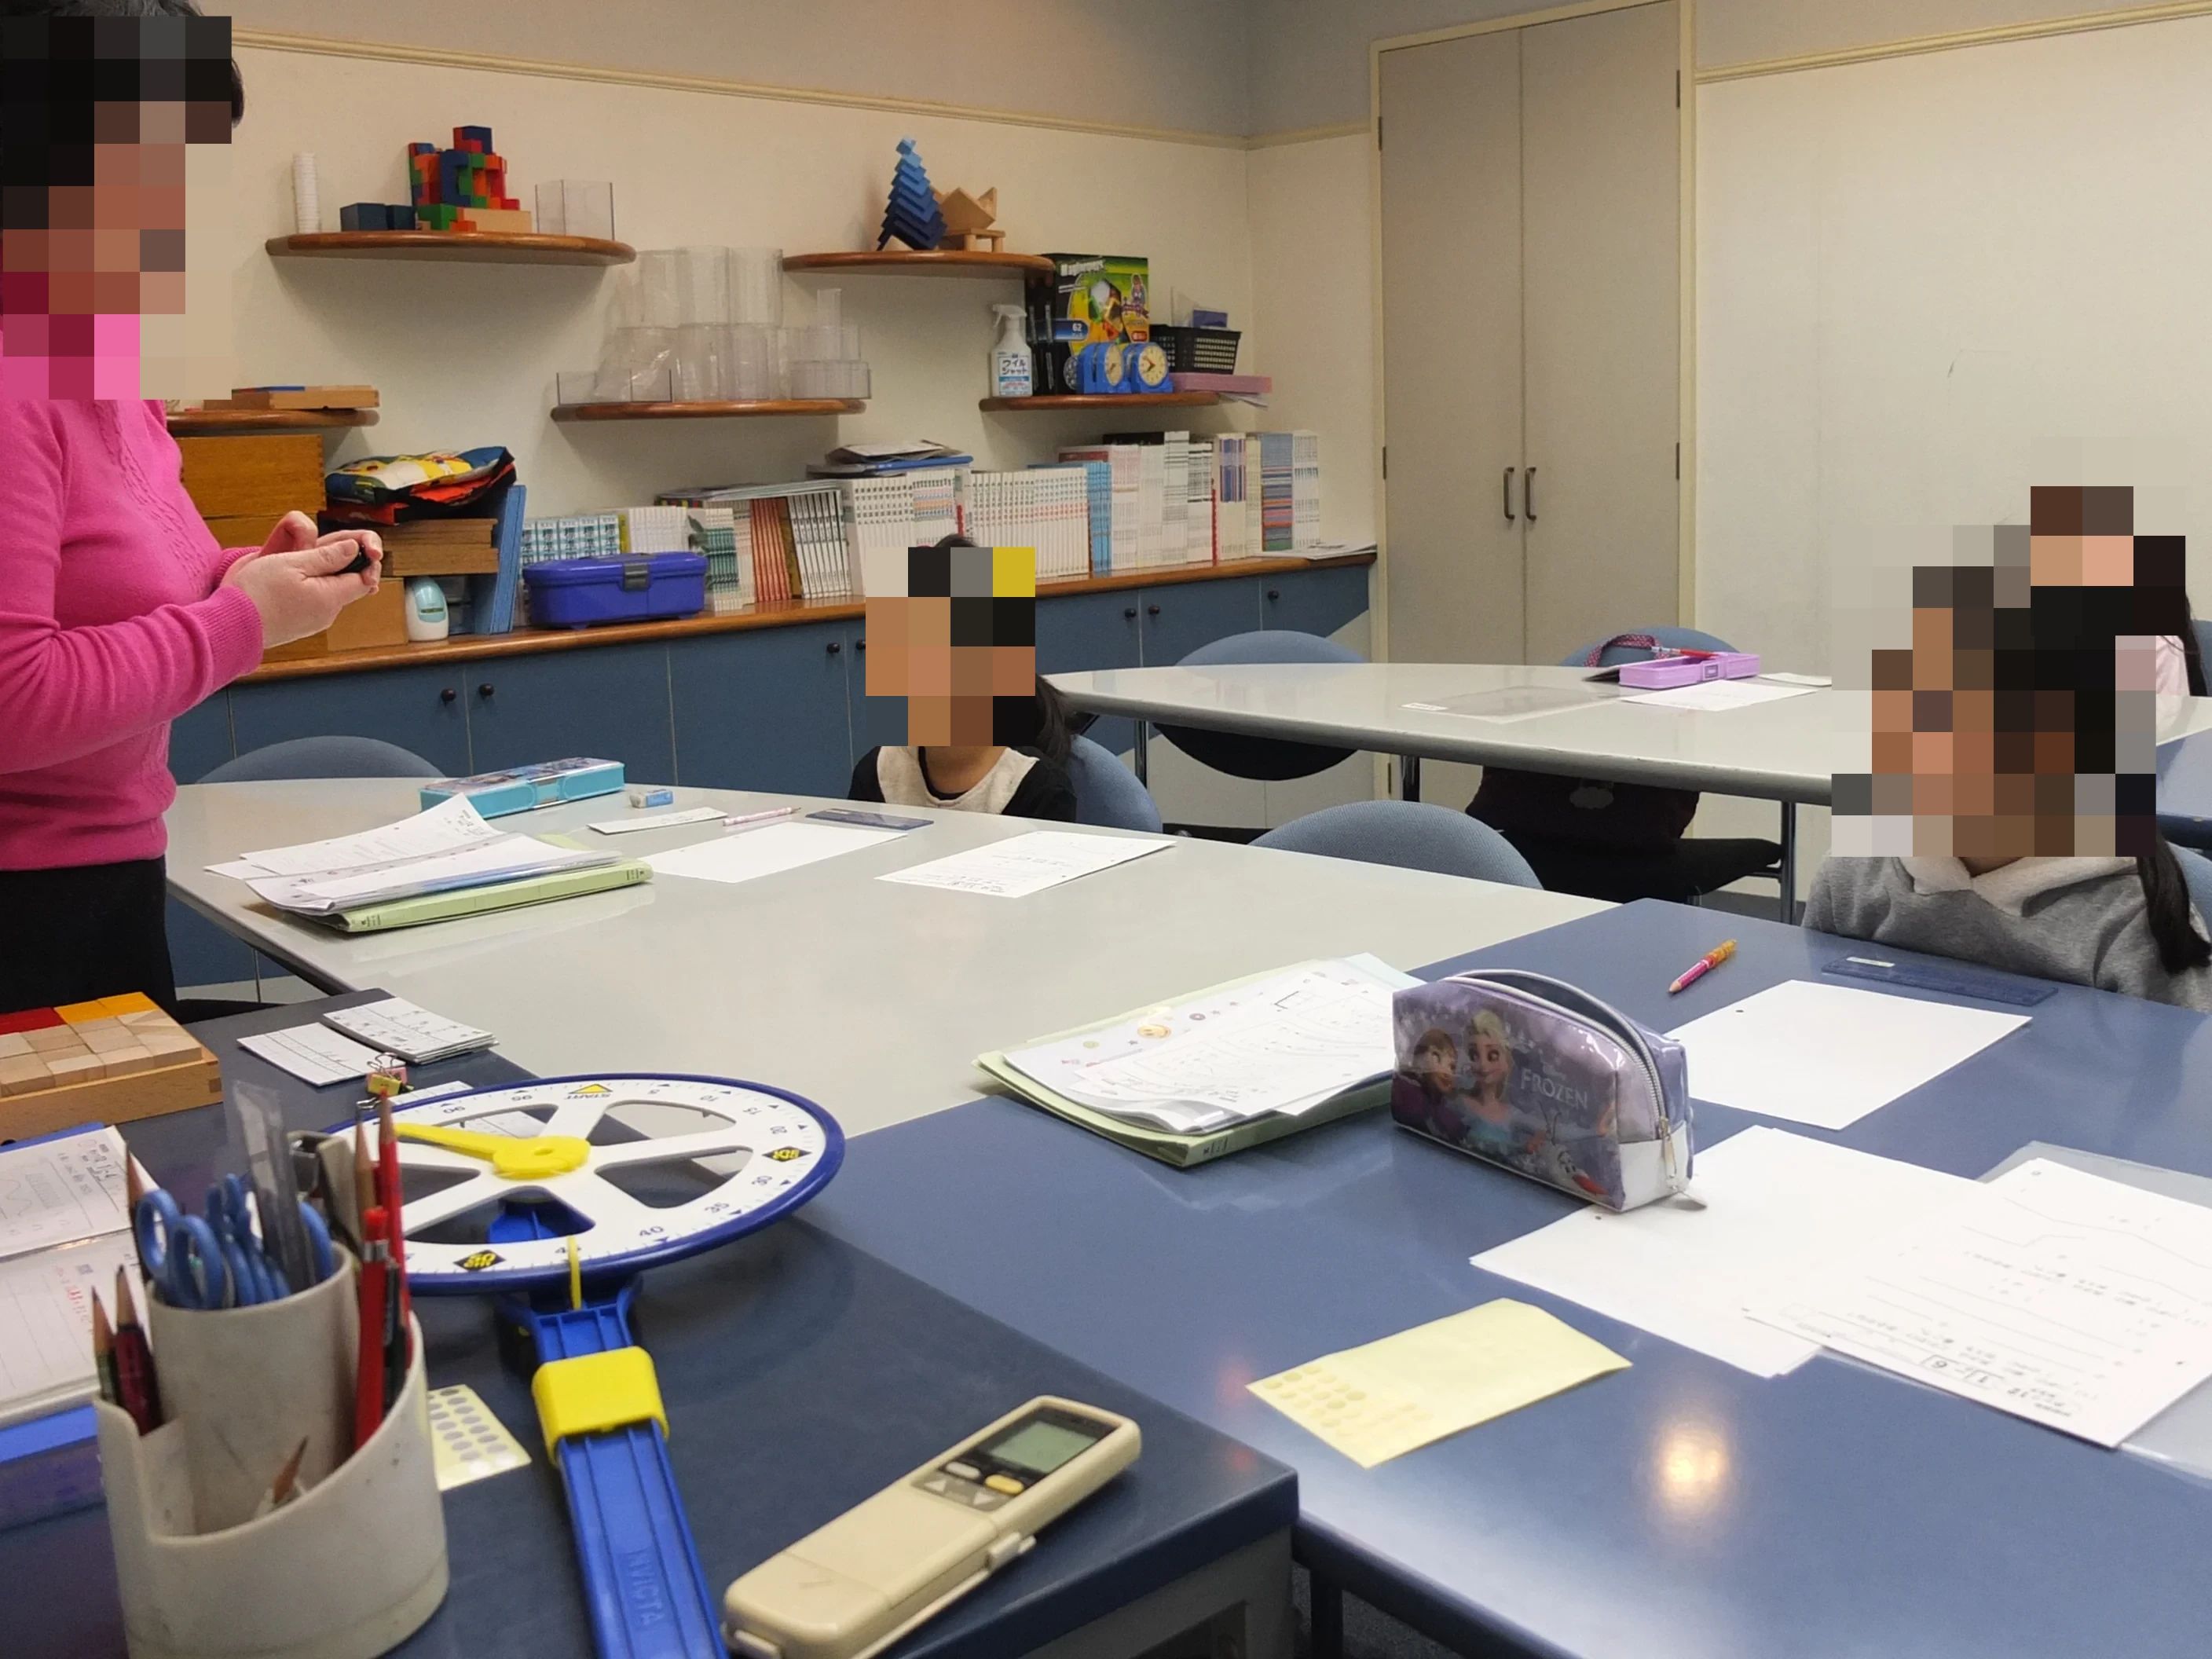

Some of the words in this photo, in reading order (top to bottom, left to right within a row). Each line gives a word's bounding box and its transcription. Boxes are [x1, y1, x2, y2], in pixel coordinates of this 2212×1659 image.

[1520, 1069, 1588, 1110] FROZEN
[443, 1105, 466, 1114] 90
[704, 1202, 730, 1213] 35
[639, 1226, 664, 1236] 40
